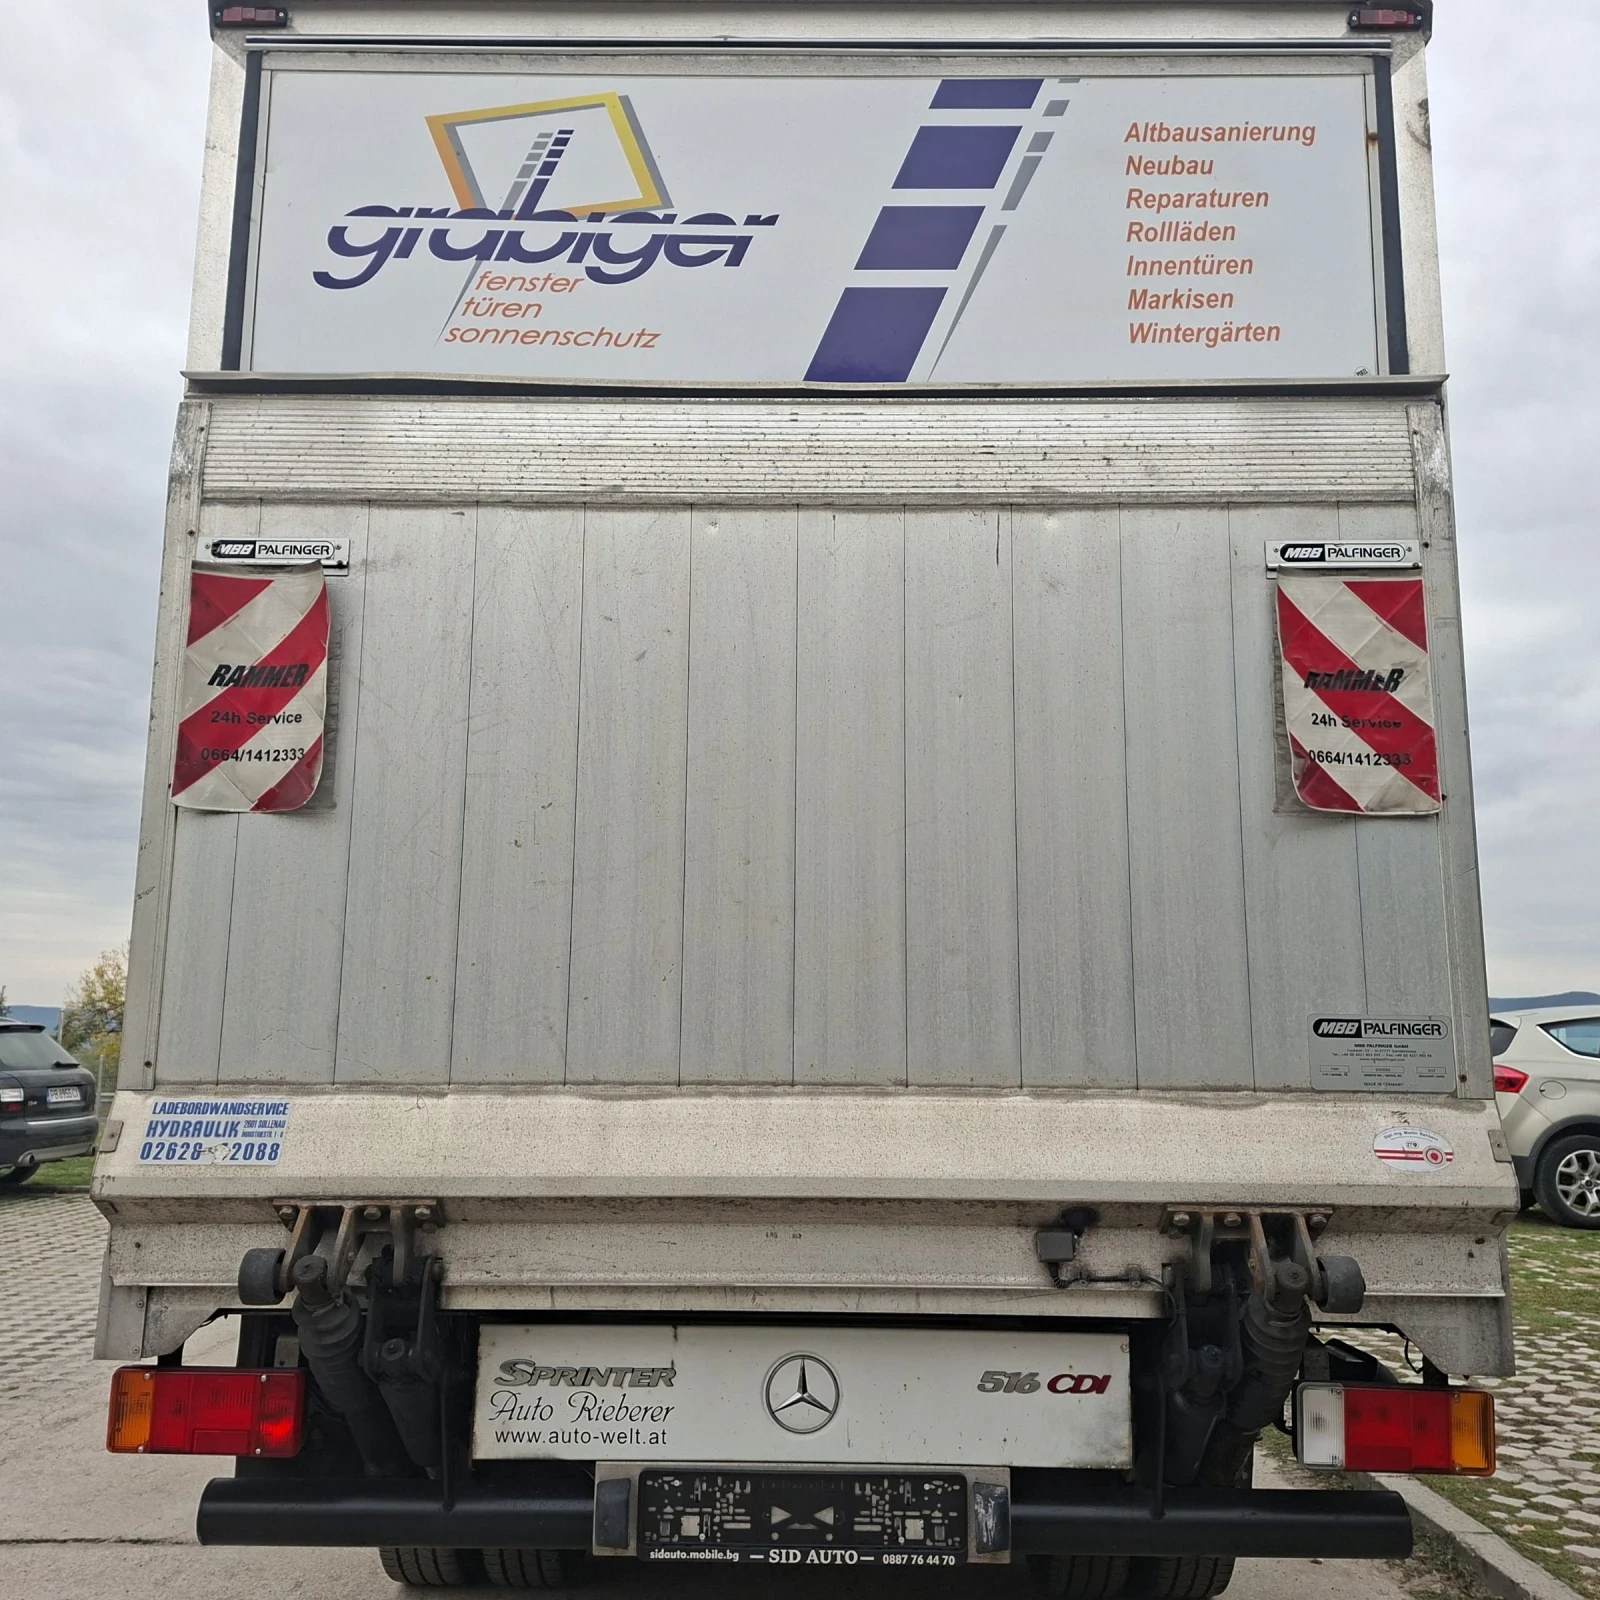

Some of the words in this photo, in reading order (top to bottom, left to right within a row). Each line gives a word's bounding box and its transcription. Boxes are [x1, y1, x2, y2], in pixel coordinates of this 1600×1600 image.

[1123, 121, 1316, 146] Altbausanierung
[1125, 155, 1214, 175] Neubau
[1125, 188, 1269, 214] Reparaturen
[313, 177, 779, 290] grabiger
[1126, 221, 1236, 242] Rollläden
[1126, 254, 1254, 276] Innentüren
[476, 271, 585, 293] fenster
[461, 297, 542, 318] türen
[1127, 288, 1234, 310] Markisen
[444, 327, 662, 349] sonnenschutz
[1129, 321, 1281, 348] Wintergärten
[258, 544, 330, 556] PALFINGER
[1284, 547, 1324, 559] MBB
[1327, 546, 1401, 559] PALFINGER
[207, 664, 310, 687] RAMMER
[211, 710, 241, 724] 24h
[246, 711, 302, 724] Service
[1311, 712, 1337, 727] 24h
[201, 747, 305, 762] 0664/1412333
[1308, 749, 1411, 766] 0664/1412333
[1317, 1022, 1359, 1035] MBB
[1364, 1022, 1442, 1036] PALFINGER
[152, 1101, 290, 1116] LADEBORDWANDSERVICE
[145, 1120, 241, 1138] HYDRAULIK
[139, 1141, 203, 1161] 02628
[494, 1358, 677, 1388] SPRINTER
[977, 1370, 1041, 1394] 516
[1047, 1373, 1112, 1394] CDI
[489, 1390, 554, 1421] Auto
[568, 1390, 675, 1423] Rieberer
[494, 1427, 667, 1445] www.auto-welt.at
[649, 1548, 740, 1562] sidauto.mobile.bg
[768, 1549, 802, 1564] SID
[805, 1549, 859, 1565] AUTO
[882, 1554, 908, 1565] 0887
[910, 1554, 924, 1565] 76
[926, 1554, 940, 1566] 44
[941, 1555, 956, 1566] 70
